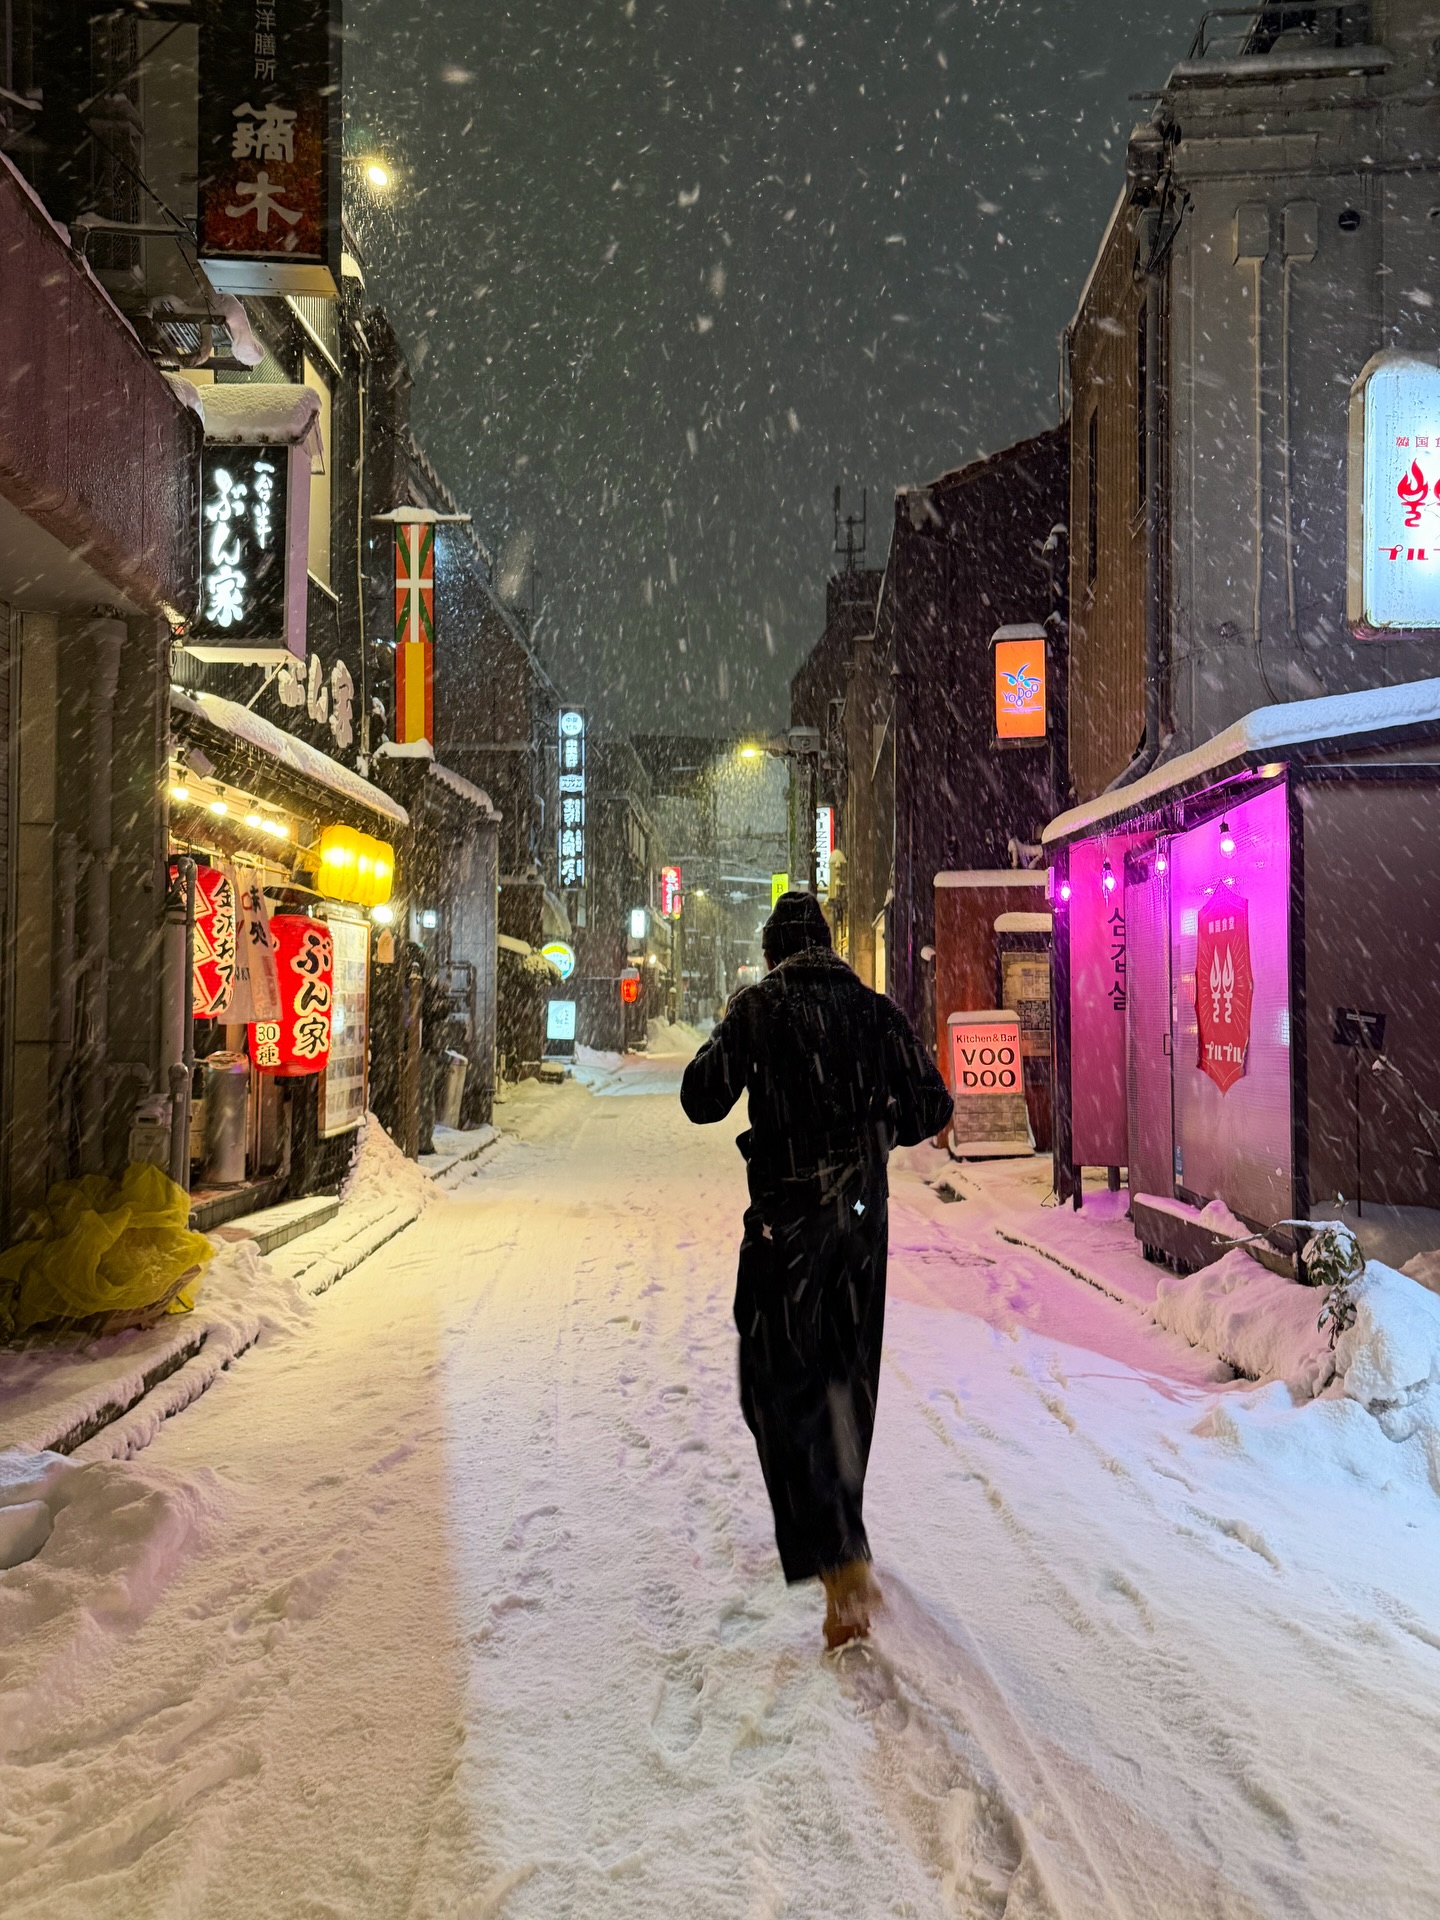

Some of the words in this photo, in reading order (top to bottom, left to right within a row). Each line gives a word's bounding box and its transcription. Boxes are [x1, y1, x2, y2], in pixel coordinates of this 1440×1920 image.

[1395, 436, 1440, 448] 韓国
[205, 468, 248, 628] ぶん家
[1378, 544, 1440, 561] プル
[299, 934, 331, 1054] ぶん家
[961, 1047, 1015, 1066] VOO
[1205, 1041, 1242, 1063] プルプル
[962, 1069, 1016, 1088] DOO
